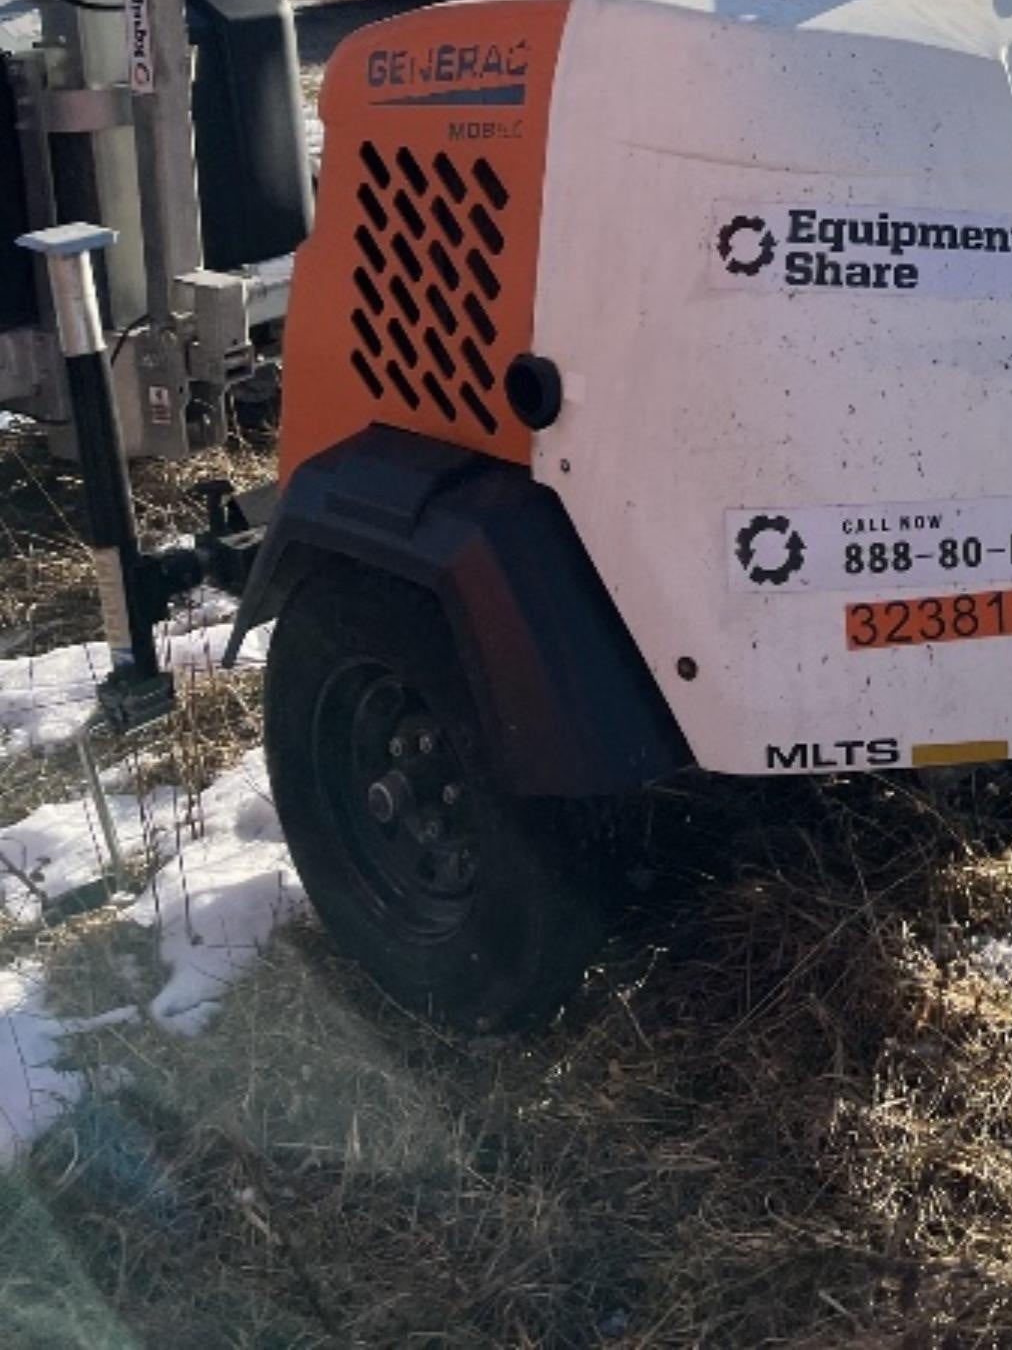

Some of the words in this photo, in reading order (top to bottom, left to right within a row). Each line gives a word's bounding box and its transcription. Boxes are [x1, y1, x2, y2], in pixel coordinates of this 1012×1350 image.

[785, 251, 919, 289] Share
[841, 517, 892, 535] CALL
[900, 514, 943, 532] NOW
[766, 738, 901, 769] MLTS
